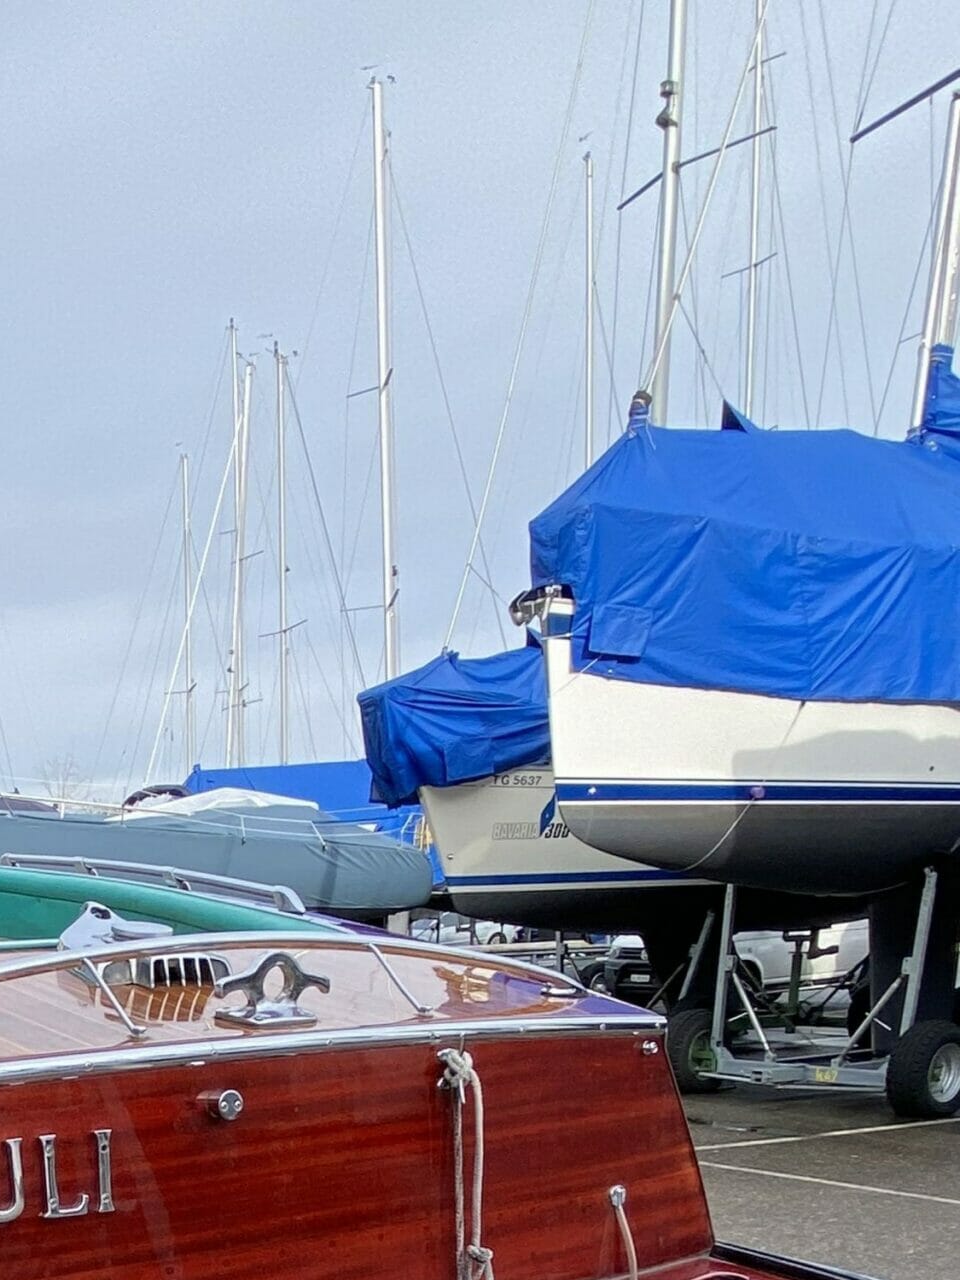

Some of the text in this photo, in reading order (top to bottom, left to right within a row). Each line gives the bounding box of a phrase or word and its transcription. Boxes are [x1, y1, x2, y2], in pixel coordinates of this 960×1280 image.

[493, 774, 542, 786] TG 5637
[492, 822, 539, 840] BAVARIA
